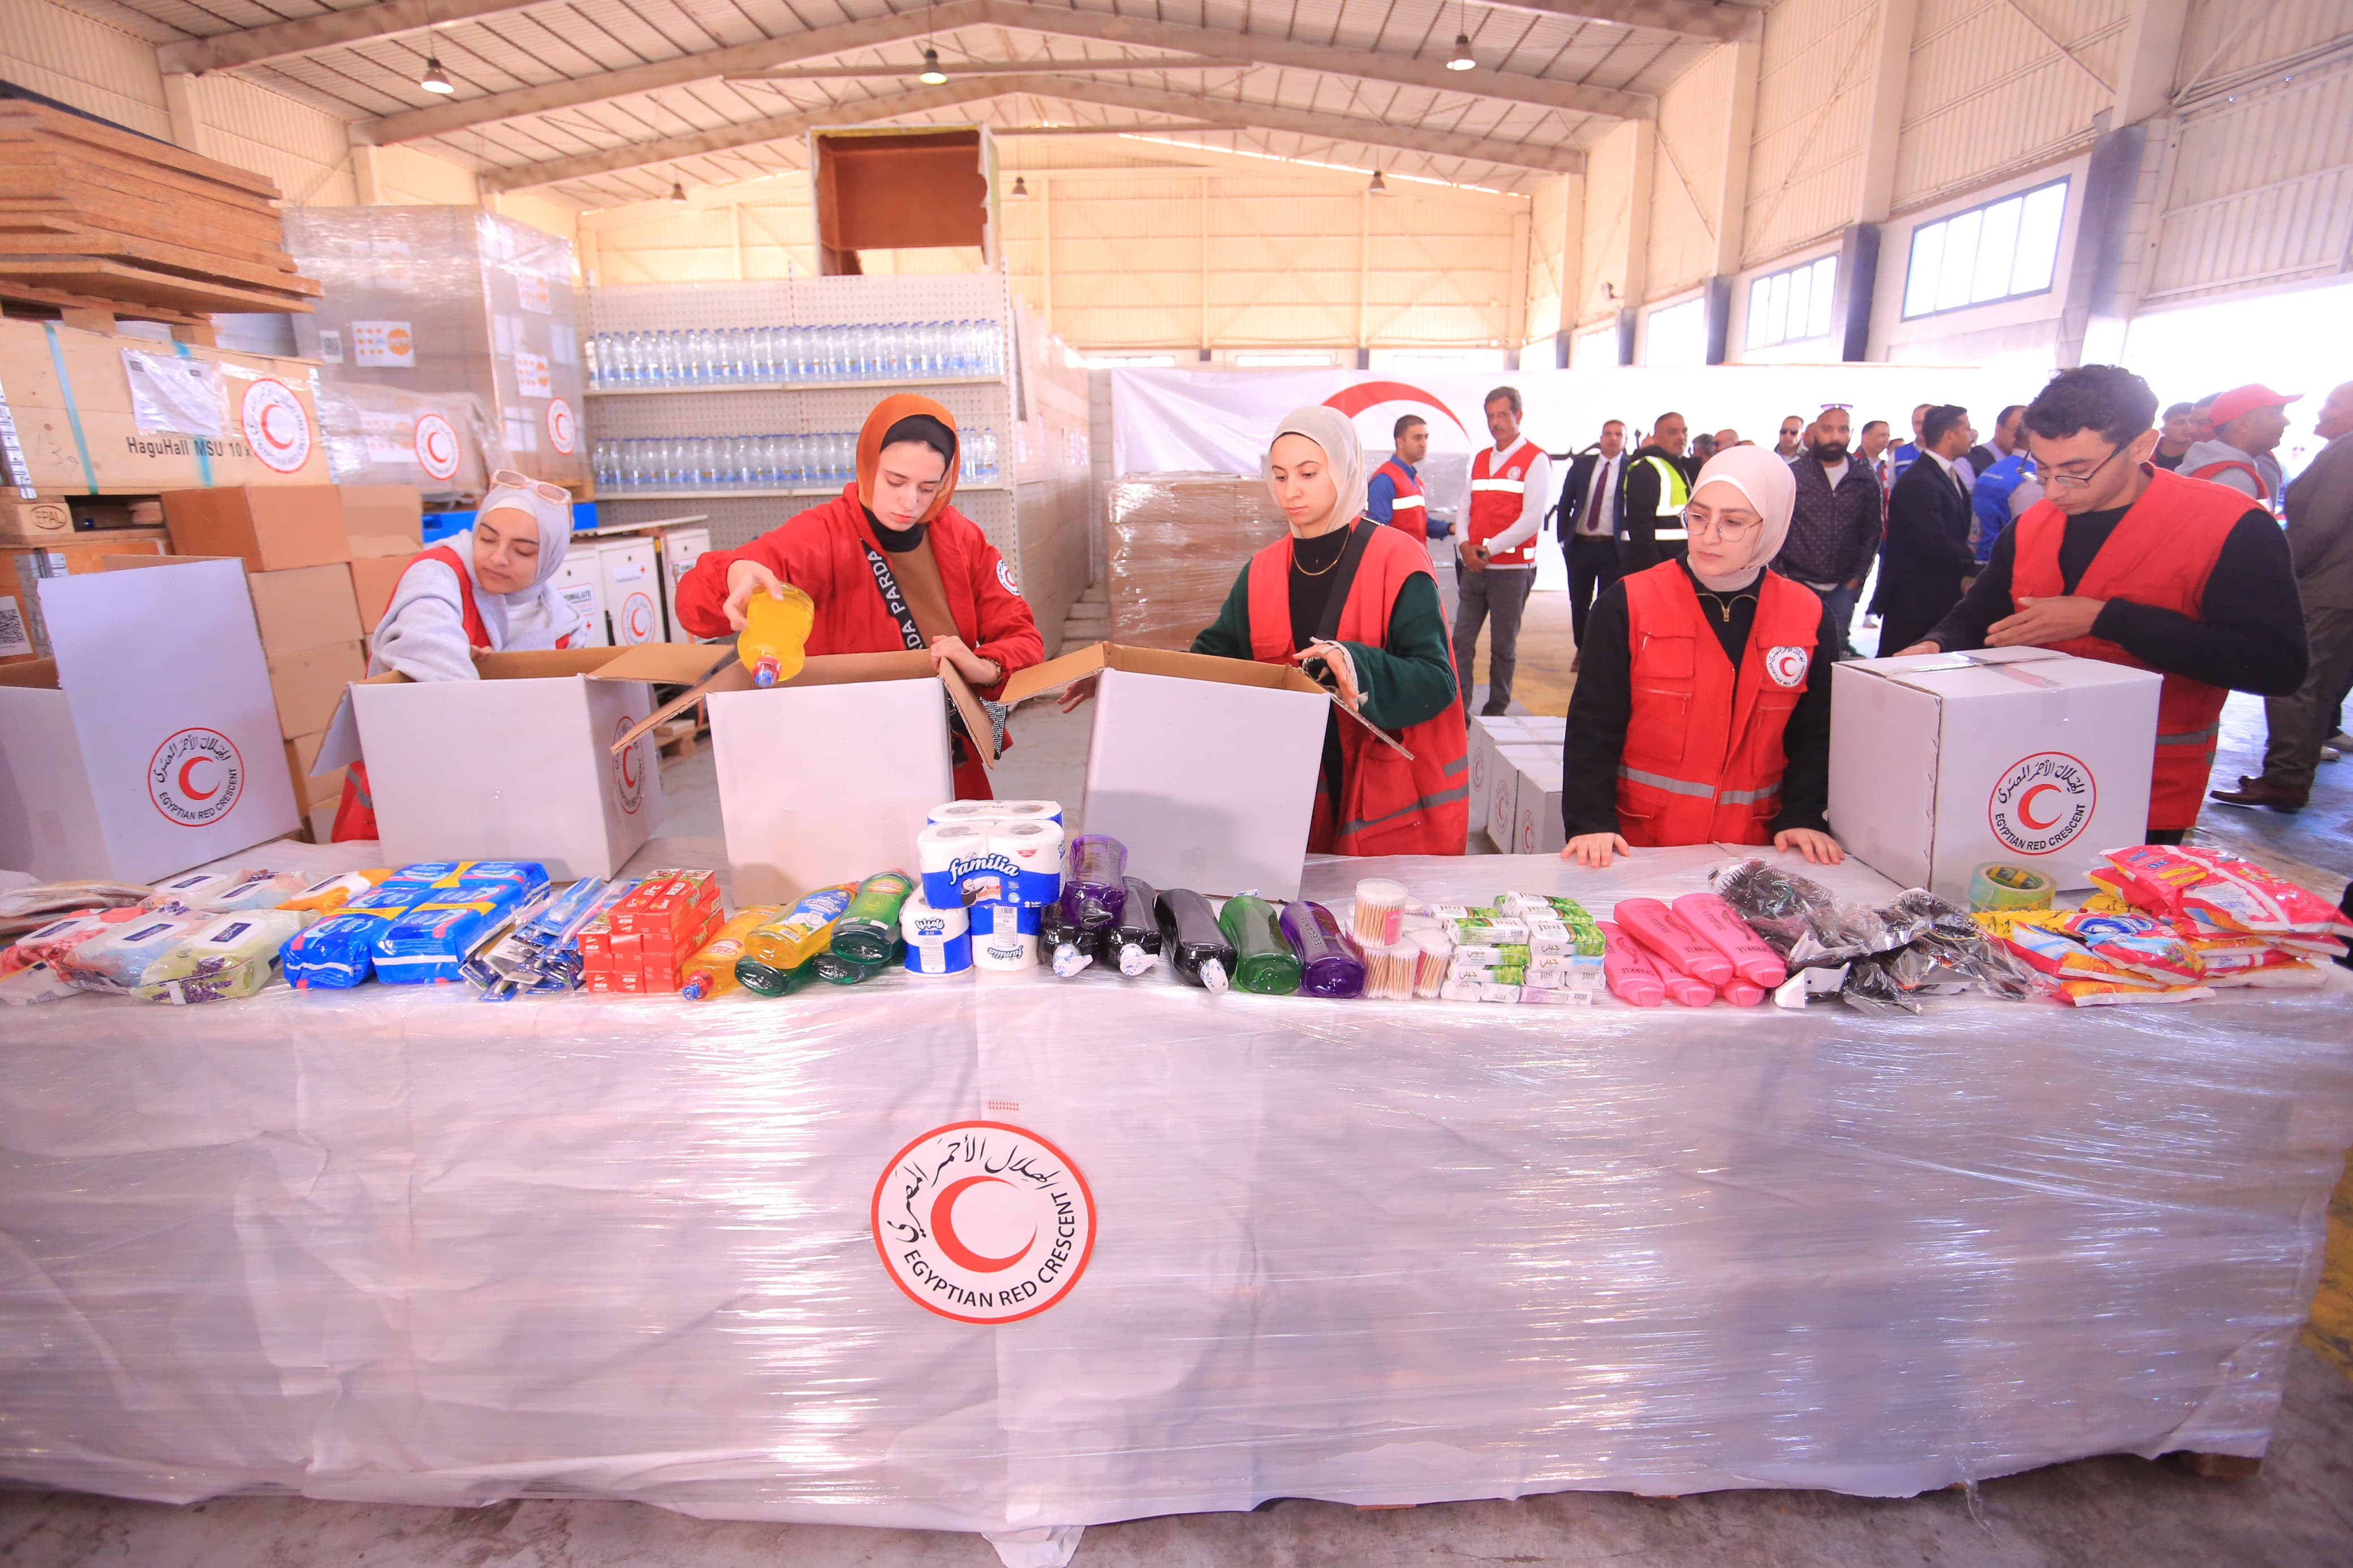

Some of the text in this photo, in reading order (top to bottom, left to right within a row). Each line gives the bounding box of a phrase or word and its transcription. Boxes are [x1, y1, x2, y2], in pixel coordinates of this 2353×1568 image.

[126, 437, 189, 457] HaguHall
[195, 438, 223, 456] MSU
[231, 443, 242, 457] 10
[36, 511, 64, 525] EPAL
[867, 551, 906, 615] PARDA
[200, 737, 231, 760] الهلال
[159, 768, 236, 819] EGYPTIAN RED CRESCENT
[2054, 765, 2085, 794] الهلال
[1996, 804, 2085, 850] EGYPTIAN RED CRESCENT
[949, 853, 1020, 885] familia
[665, 882, 686, 896] RED
[915, 918, 945, 930] فاميليا
[1299, 917, 1322, 945] ELEGANTE
[988, 945, 1023, 960] familia
[931, 1134, 986, 1188] الأحمر
[985, 1144, 1061, 1190] الهلال
[903, 1191, 1075, 1307] EGYPTIAN RED CRESCENT
